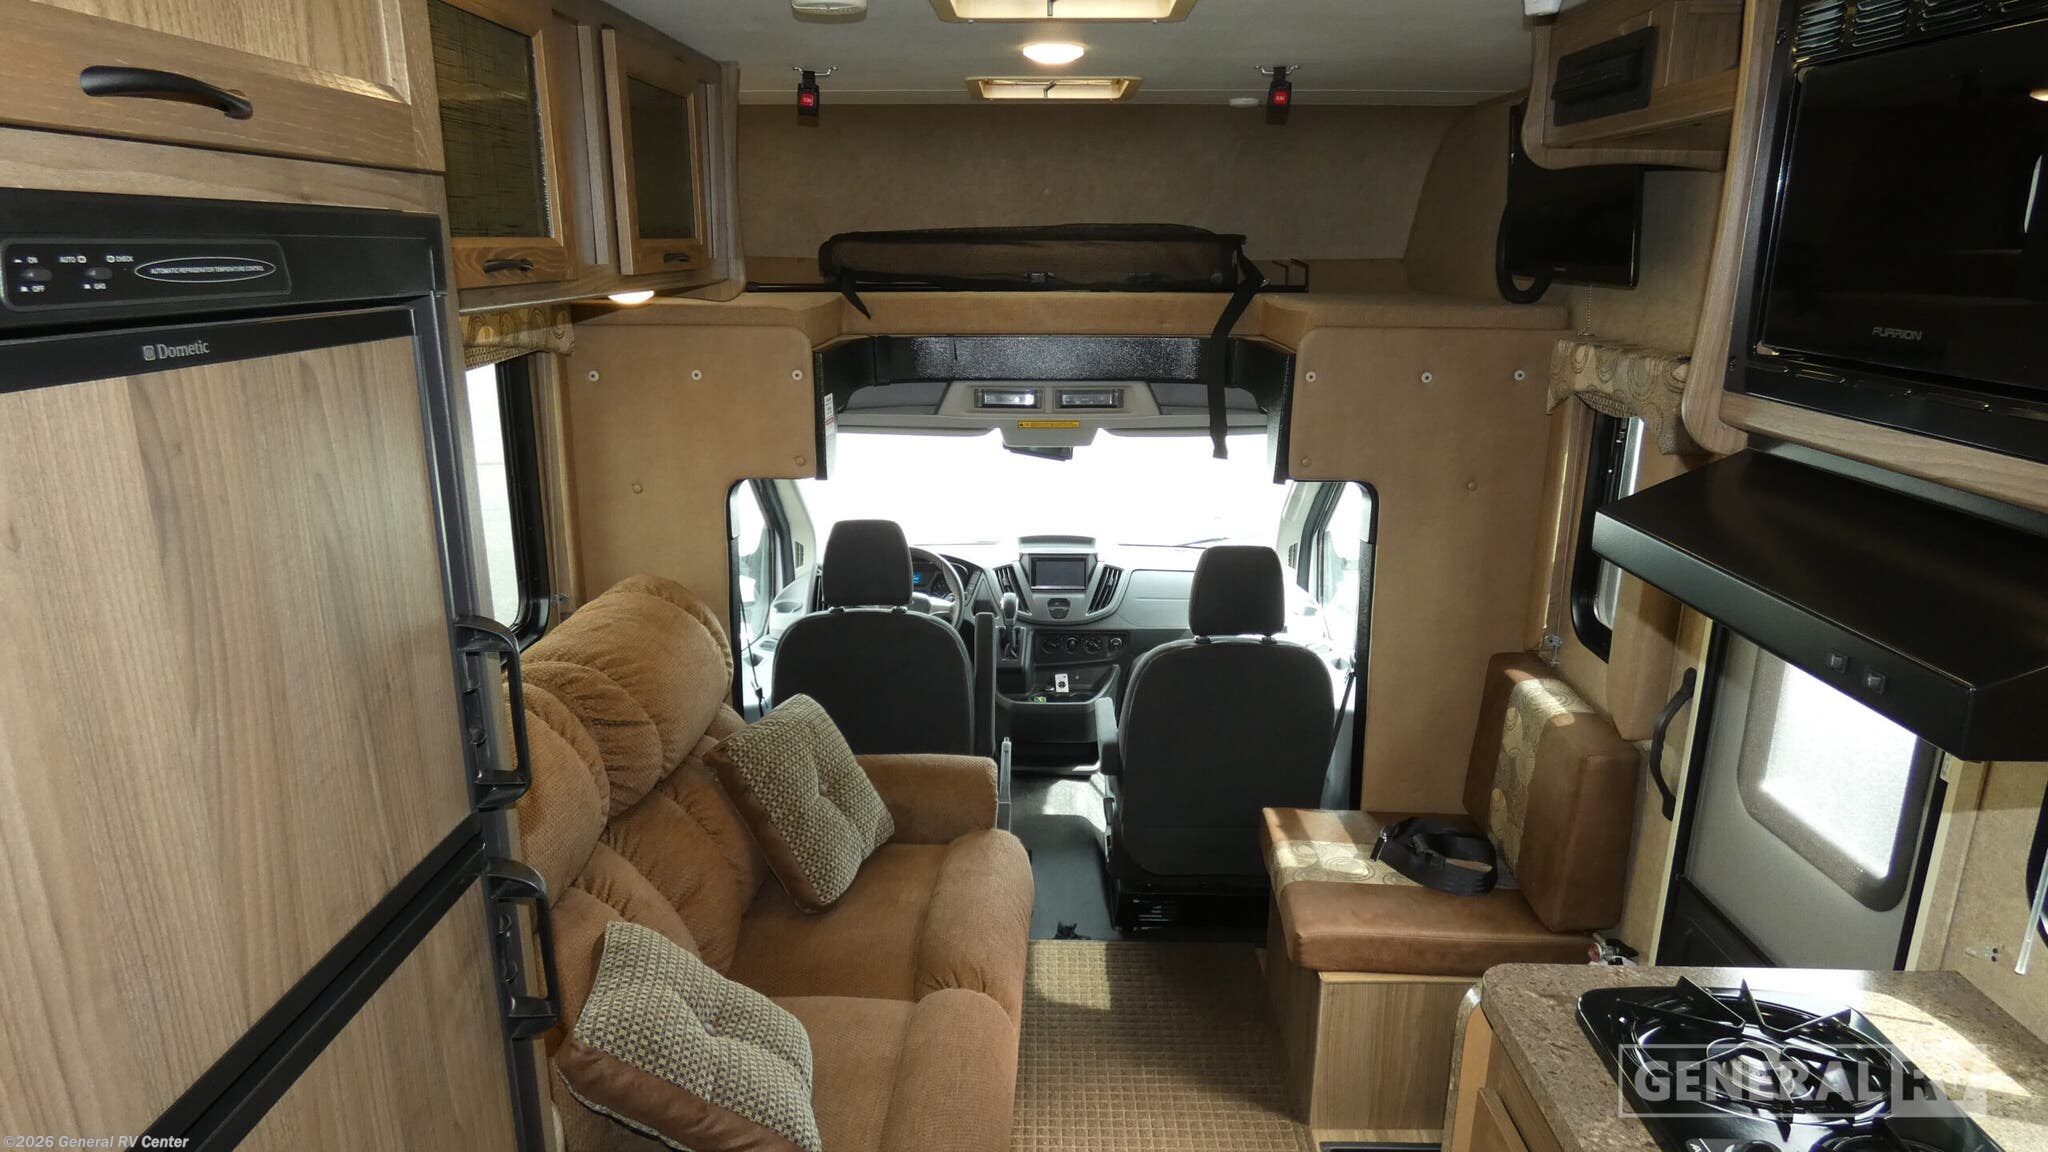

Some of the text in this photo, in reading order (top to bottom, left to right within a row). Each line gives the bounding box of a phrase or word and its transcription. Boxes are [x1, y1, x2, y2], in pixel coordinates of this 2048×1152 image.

[27, 256, 39, 264] ON
[31, 285, 46, 293] OFF
[1872, 327, 1922, 341] FURRION
[157, 339, 210, 360] Dometic
